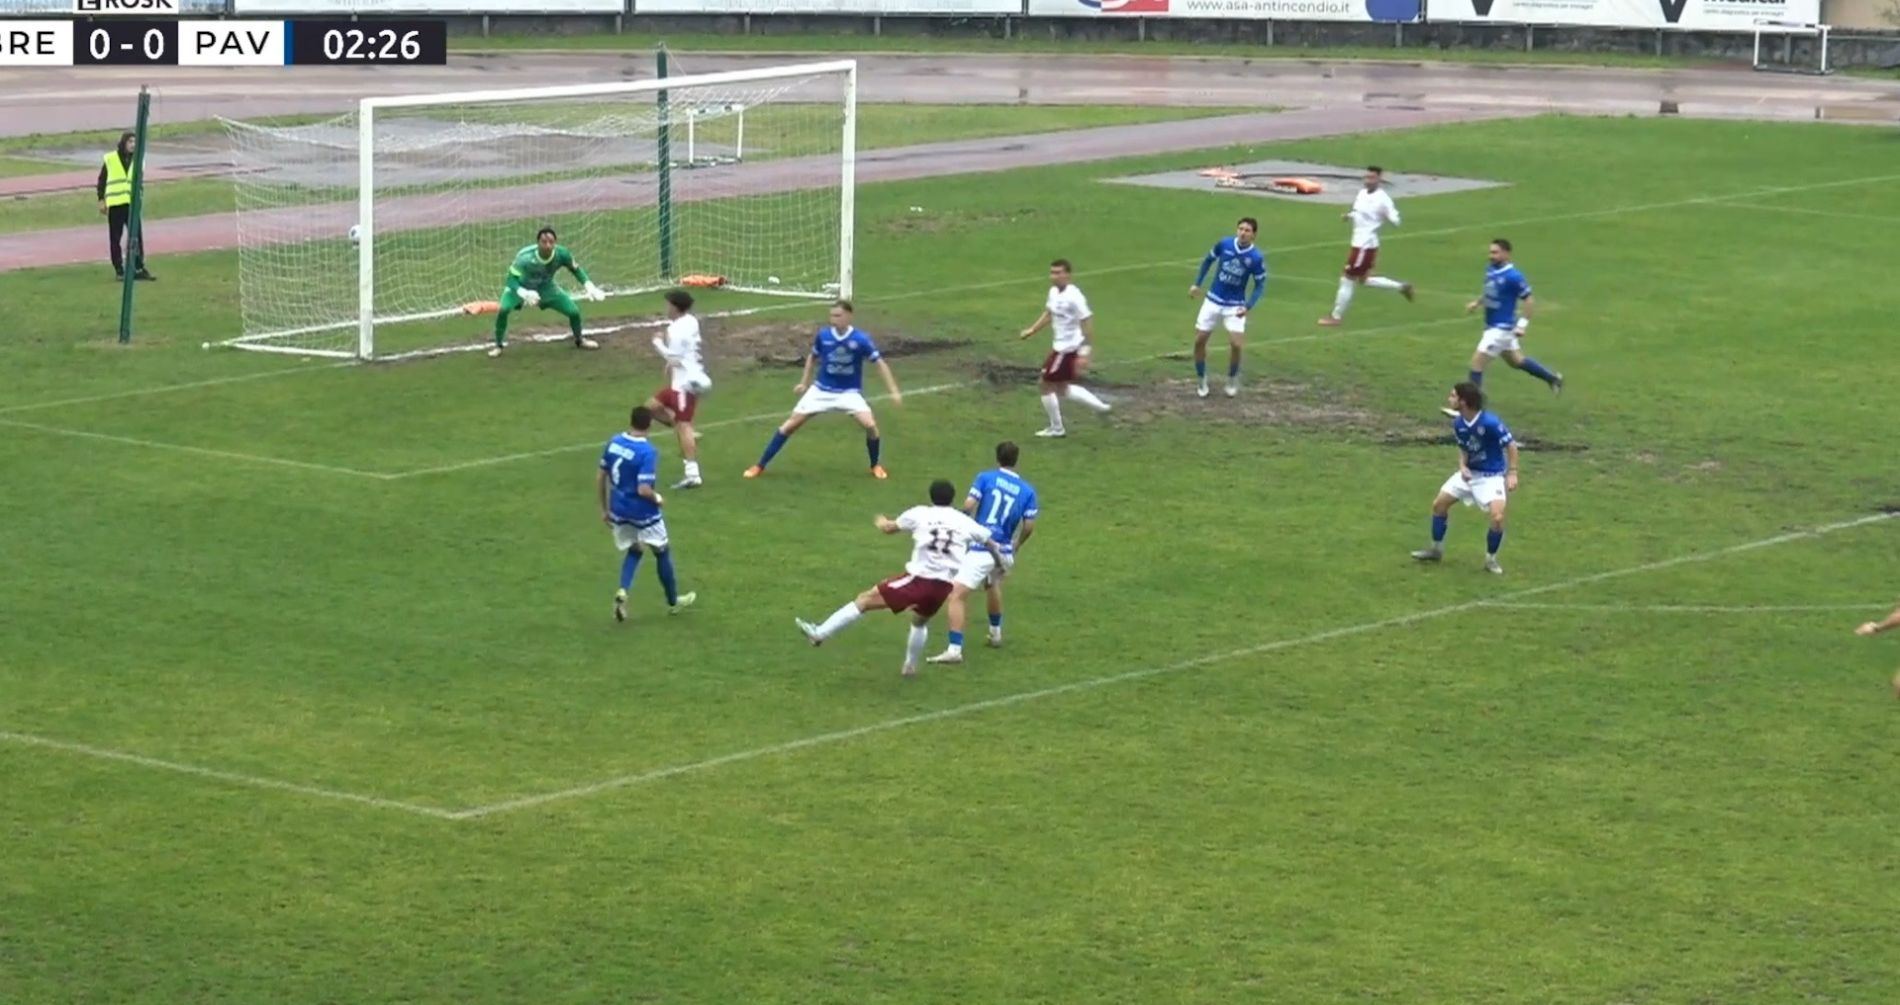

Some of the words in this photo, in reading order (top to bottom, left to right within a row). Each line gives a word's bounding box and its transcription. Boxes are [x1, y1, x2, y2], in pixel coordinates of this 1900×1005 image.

[1187, 0, 1350, 13] www.asa-antincendio.it
[986, 488, 1016, 526] 27
[927, 528, 954, 554] 11
